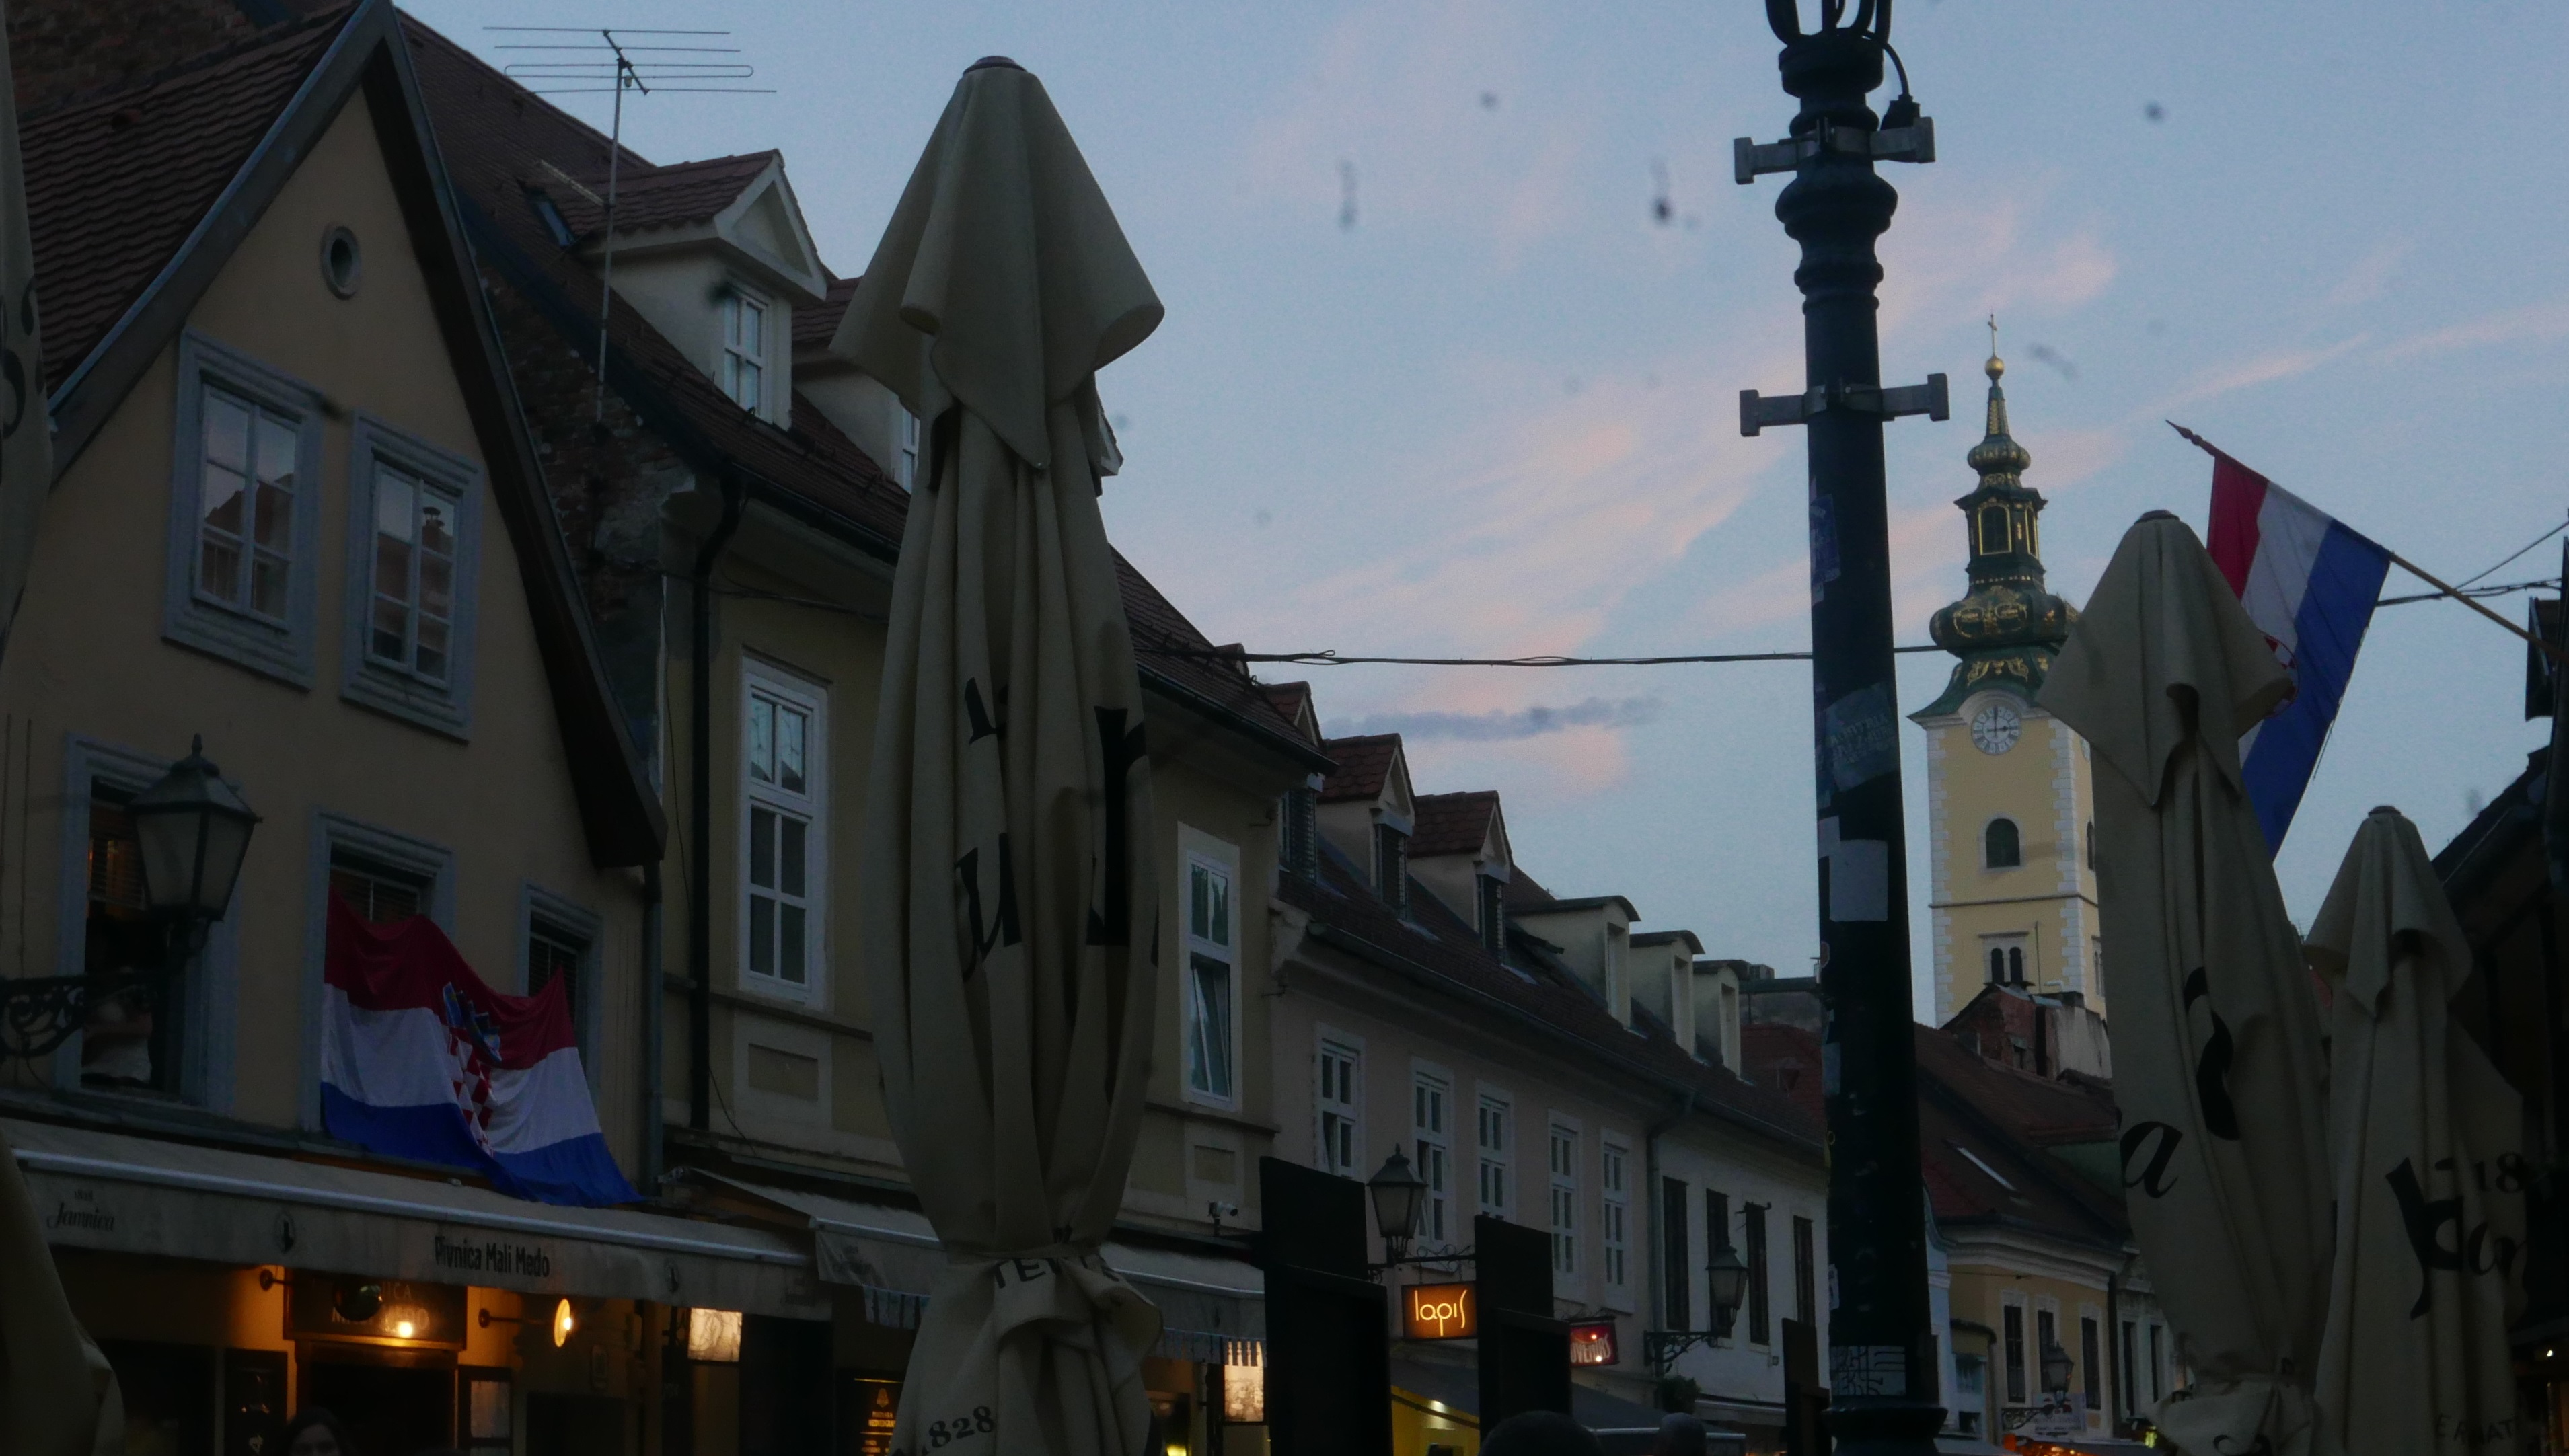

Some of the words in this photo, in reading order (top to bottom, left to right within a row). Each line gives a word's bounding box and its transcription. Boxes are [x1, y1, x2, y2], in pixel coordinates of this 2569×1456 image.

[435, 1235, 482, 1270] Pivnica
[486, 1242, 512, 1274] Mali
[516, 1246, 550, 1278] Medo
[1414, 1289, 1468, 1337] lapis
[922, 1406, 995, 1456] 828
